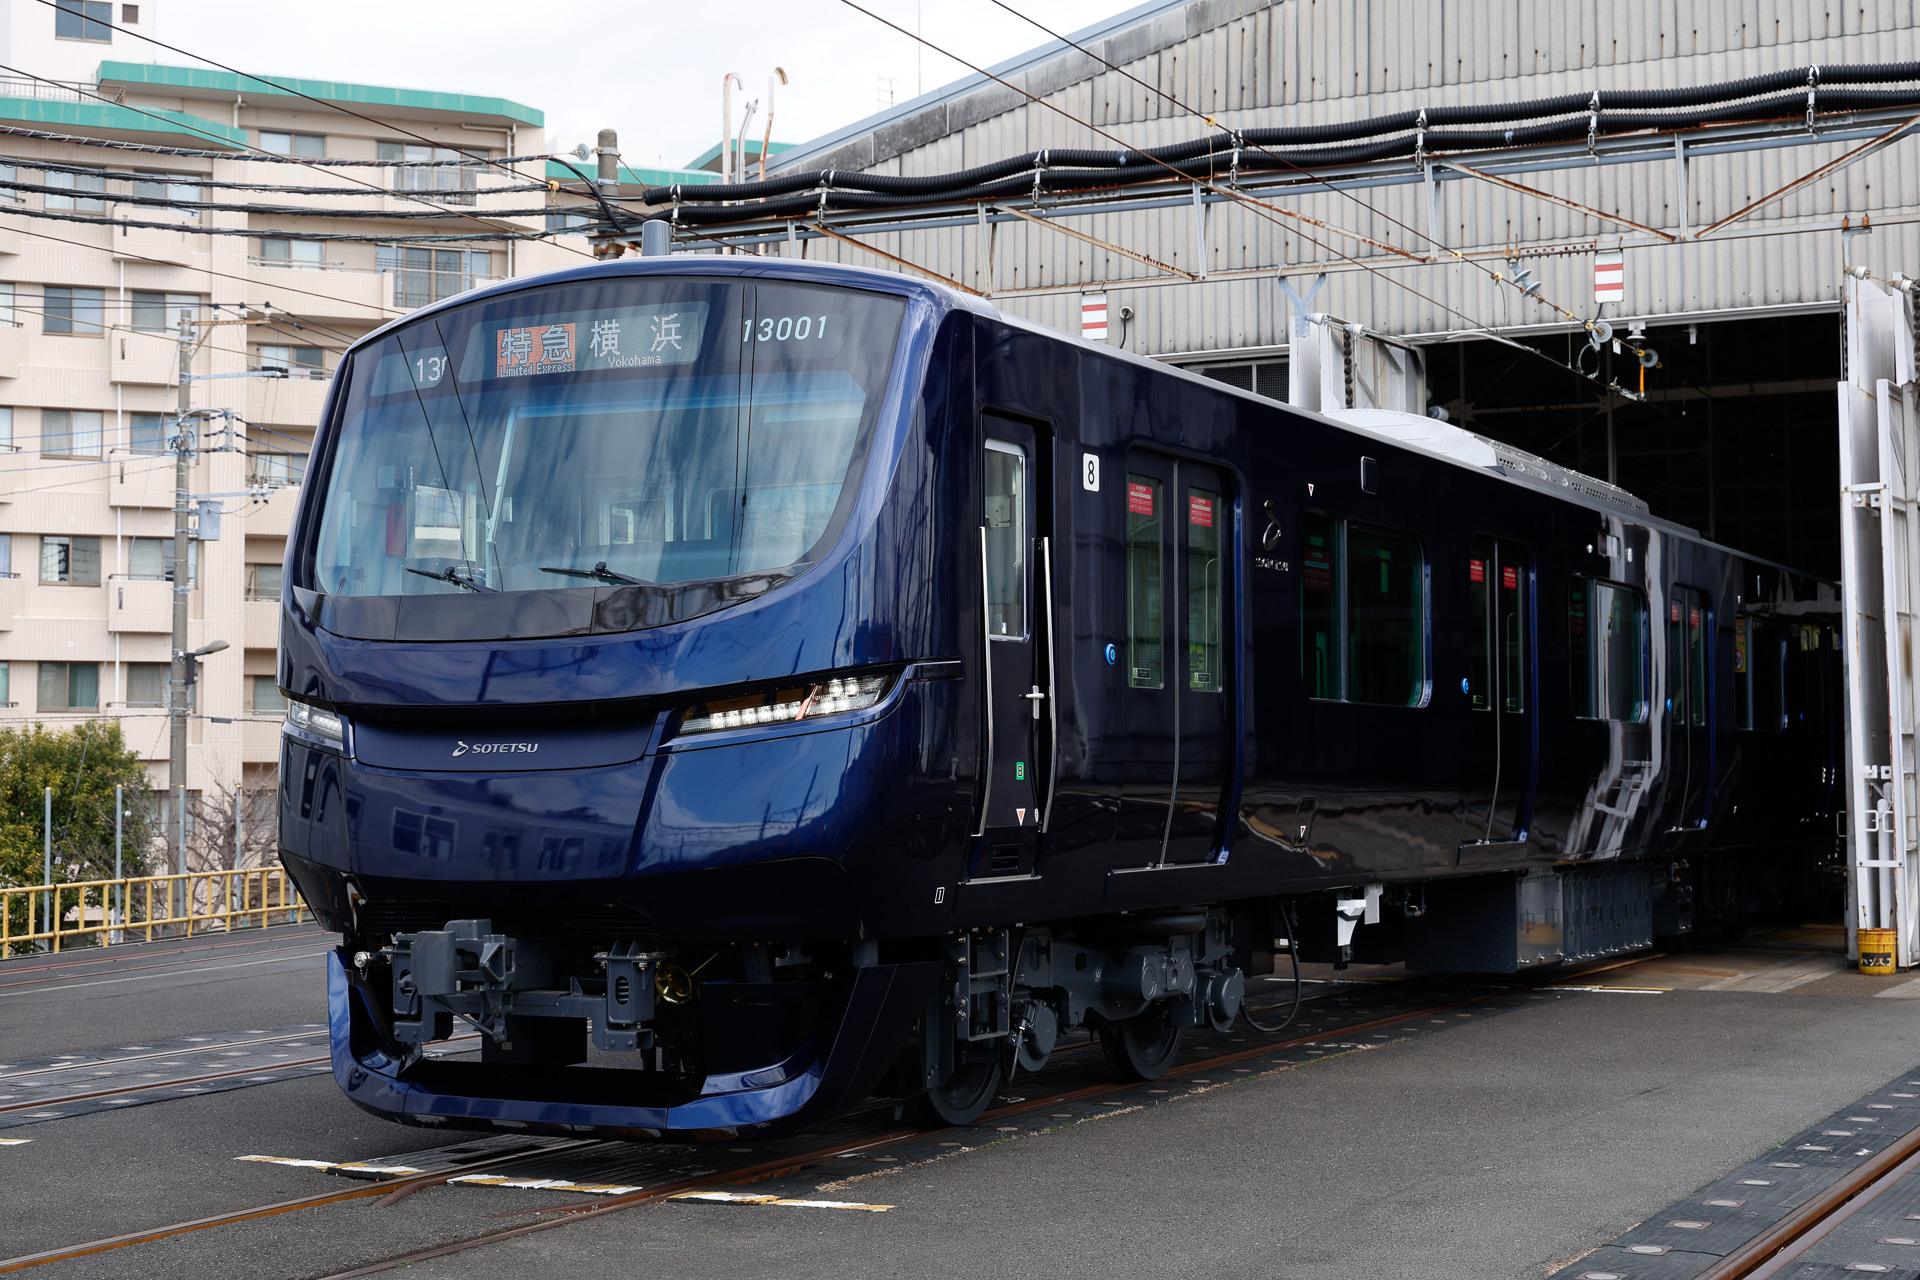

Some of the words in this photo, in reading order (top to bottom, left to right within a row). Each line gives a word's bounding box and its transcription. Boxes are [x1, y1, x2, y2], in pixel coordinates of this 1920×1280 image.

[501, 324, 571, 365] 特急
[590, 312, 682, 357] 横浜
[743, 316, 827, 342] 13001
[500, 363, 533, 377] Limited
[536, 362, 572, 375] Express
[607, 354, 661, 368] Yokohama
[1087, 459, 1095, 485] 8
[471, 742, 539, 754] SOTETSU
